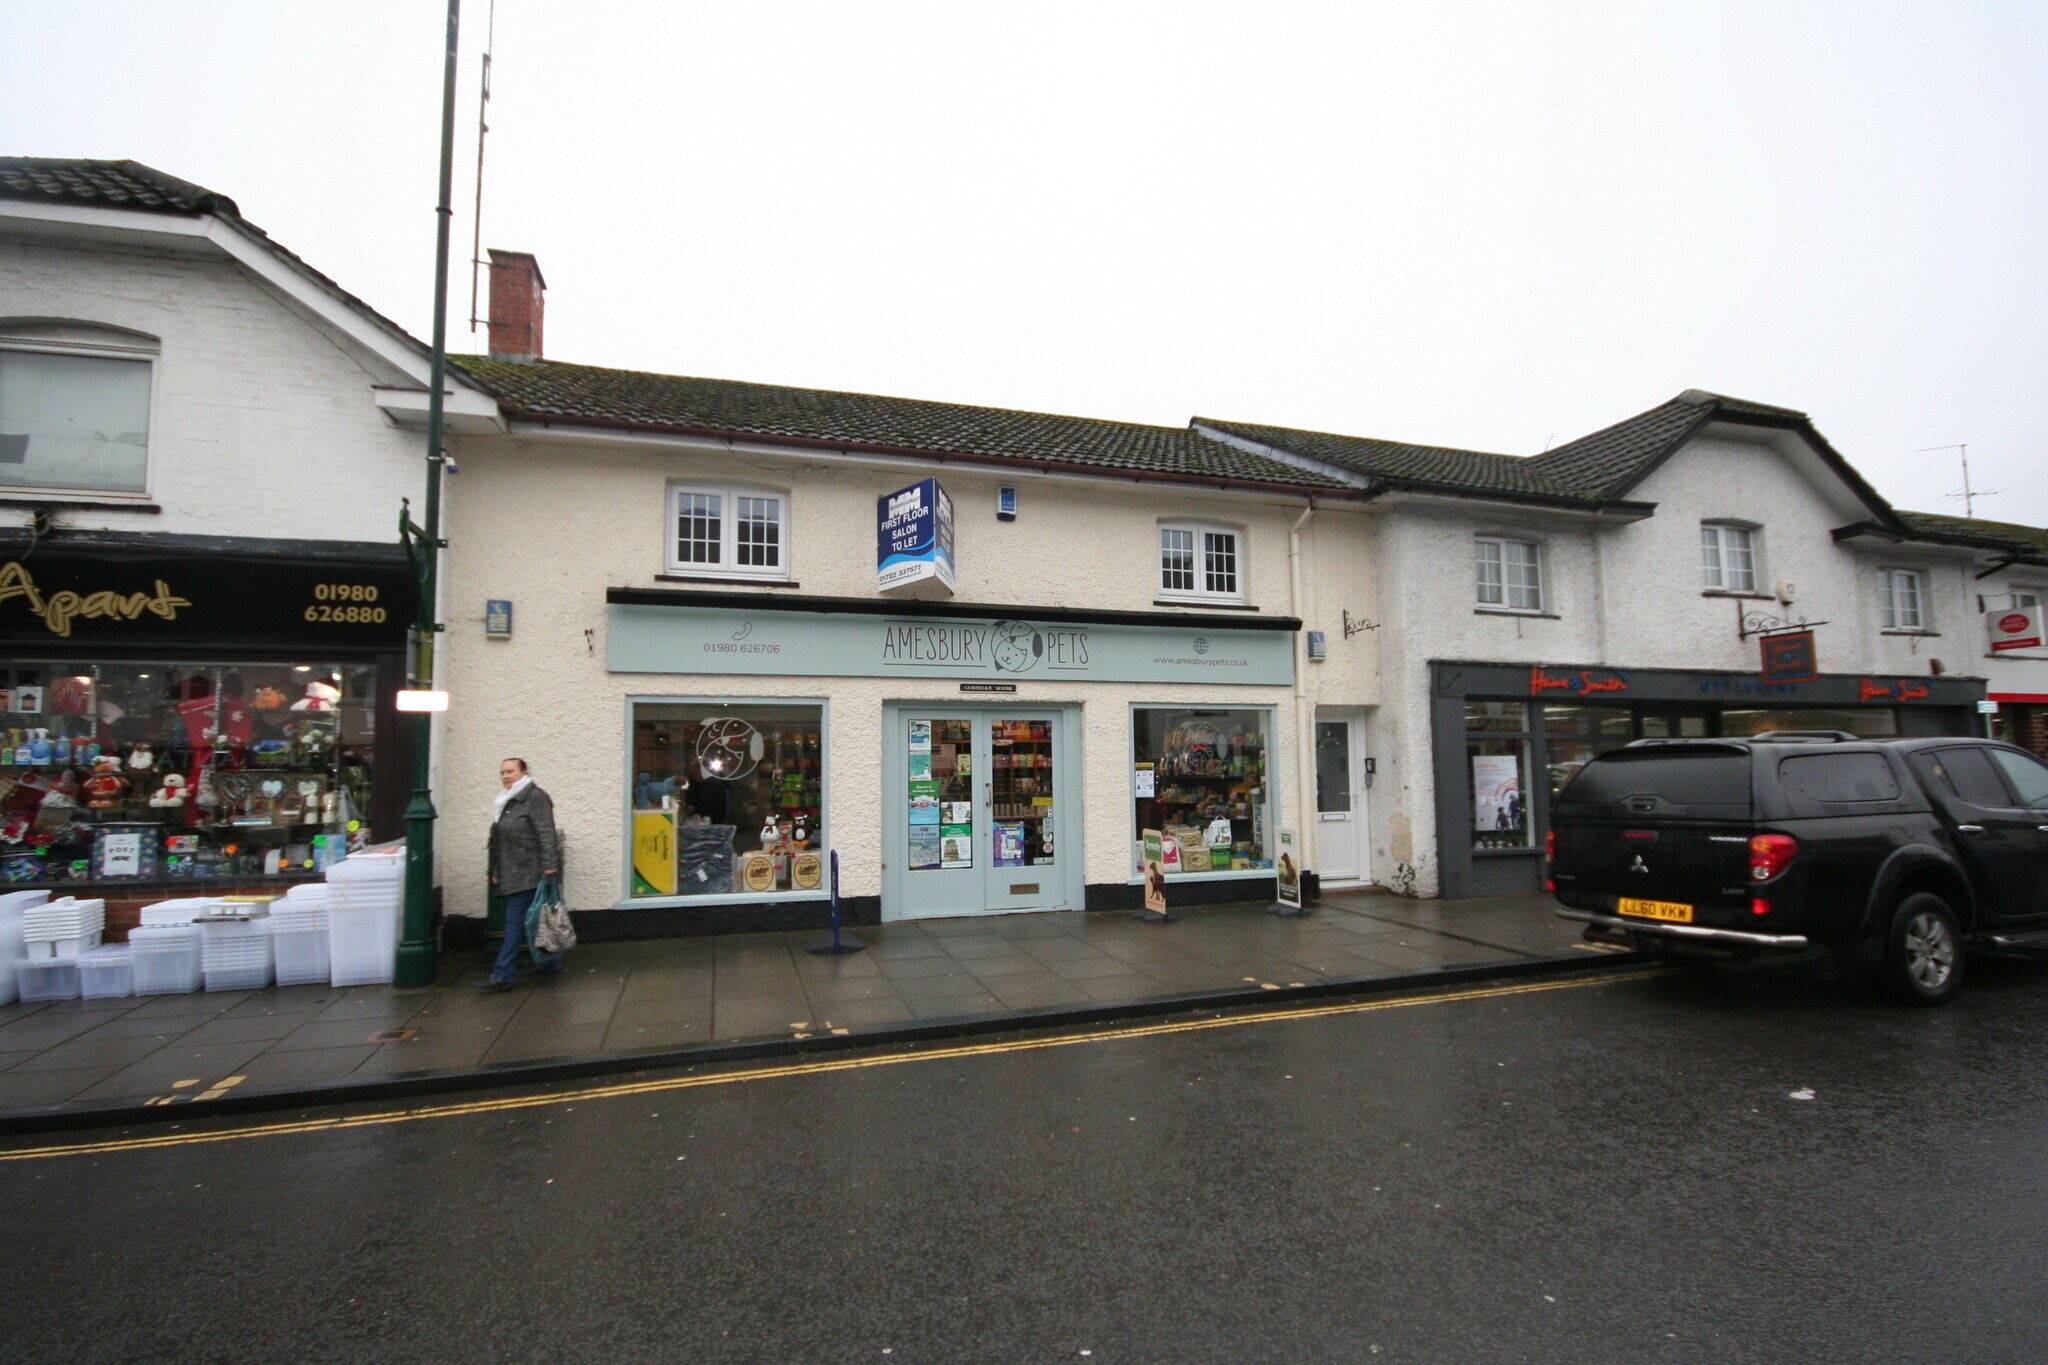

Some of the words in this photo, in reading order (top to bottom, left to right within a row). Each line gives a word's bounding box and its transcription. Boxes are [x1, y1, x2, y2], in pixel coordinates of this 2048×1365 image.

[881, 517, 901, 532] FIRST
[902, 506, 929, 524] FLOOR
[892, 523, 917, 540] SALON
[891, 541, 902, 552] TO
[903, 535, 918, 548] LET
[879, 571, 897, 583] 01722
[898, 564, 922, 576] 337577
[0, 562, 192, 637] Apart
[314, 584, 378, 602] 01980
[304, 605, 386, 623] 626880
[2000, 622, 2026, 630] OFFICE
[703, 642, 738, 653] 01980
[740, 643, 780, 654] 626706
[883, 626, 987, 662] AMESBURY
[1047, 632, 1089, 664] PETS
[1152, 658, 1249, 667] www.amesburypets.co.uk
[1623, 900, 1656, 916] LL60
[1660, 903, 1687, 920] VKW
